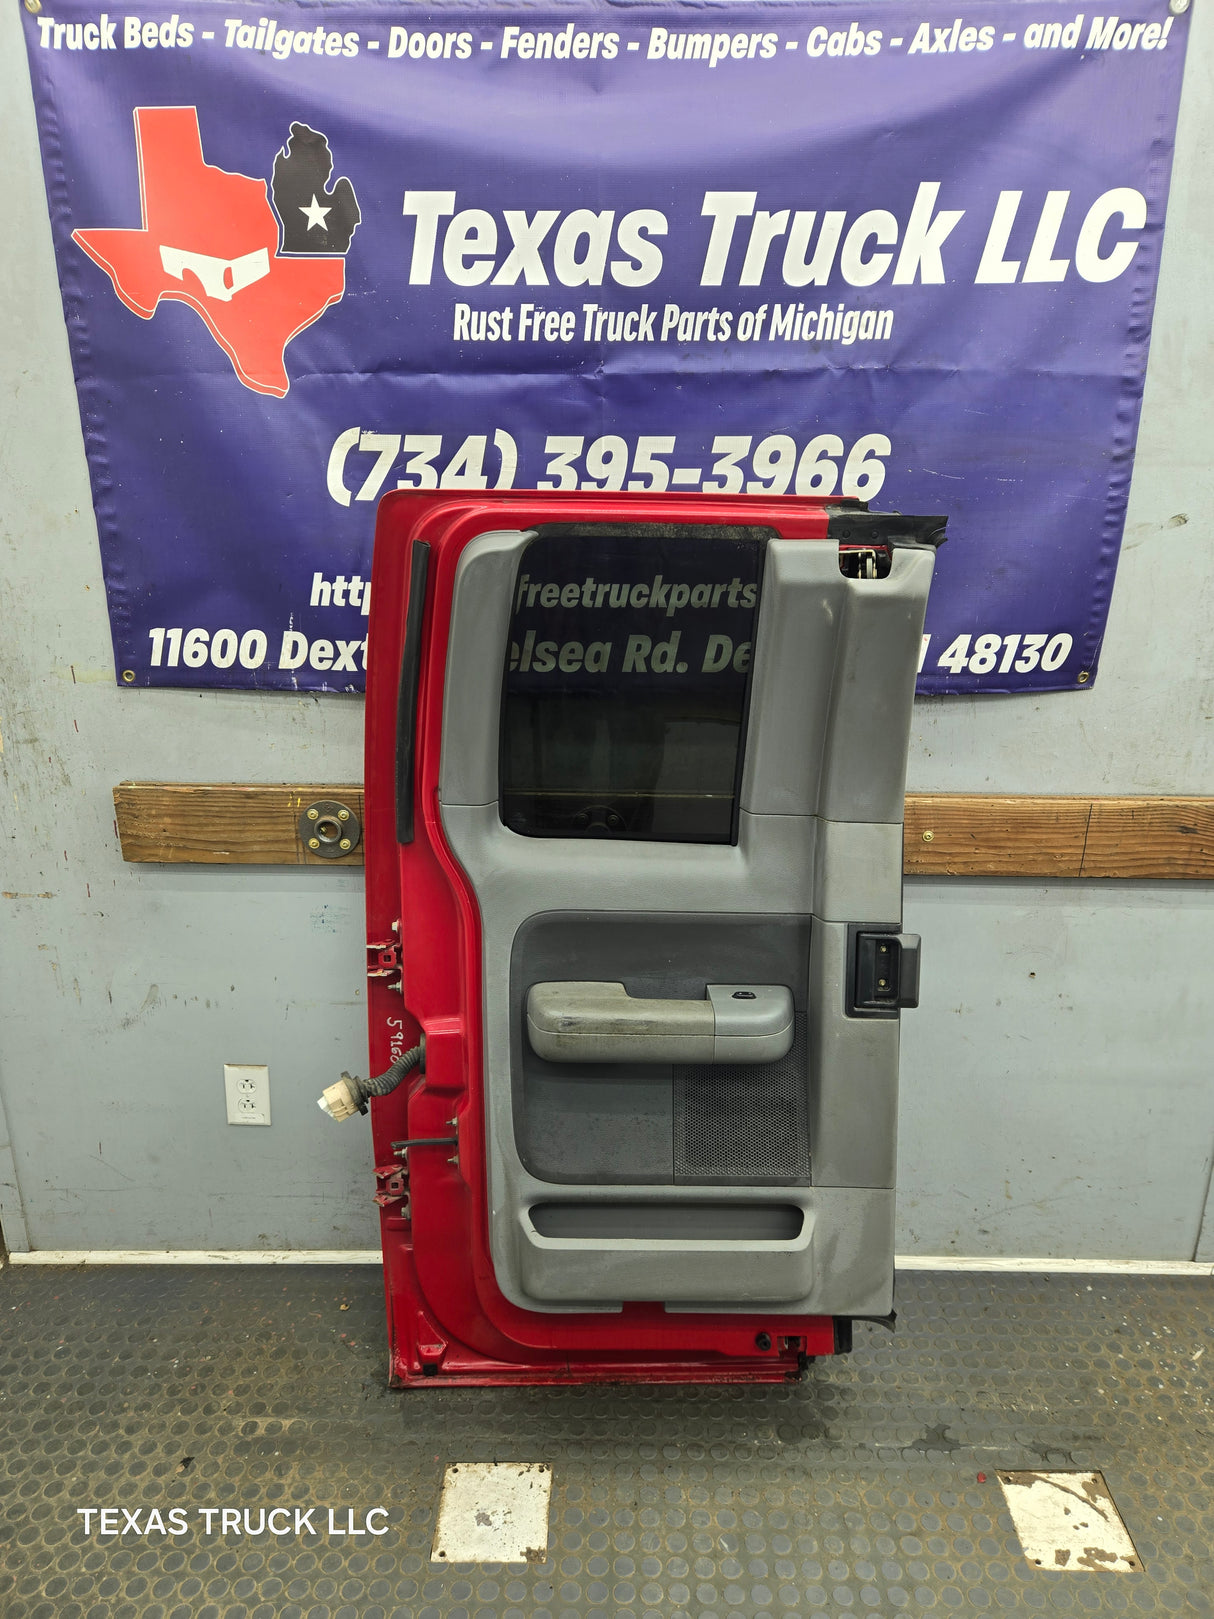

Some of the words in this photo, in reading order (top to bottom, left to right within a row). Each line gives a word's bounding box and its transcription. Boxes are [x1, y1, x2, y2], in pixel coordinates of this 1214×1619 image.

[37, 14, 117, 50] Truck
[124, 14, 194, 48] Beds
[224, 17, 360, 60] Tailgates
[388, 27, 473, 59] Doors
[500, 24, 619, 60] Fenders
[647, 27, 778, 68] Bumpers
[807, 22, 883, 57] Cabs
[907, 19, 996, 55] Axles
[1023, 14, 1084, 50] and
[1085, 16, 1175, 51] More!
[402, 190, 669, 287] Texas
[700, 181, 966, 287] Truck
[974, 187, 1148, 284] LLC
[453, 303, 513, 342] Rust
[518, 304, 576, 342] Free
[583, 303, 656, 342] Truck
[660, 303, 733, 342] Parts
[737, 303, 769, 342] of
[768, 303, 894, 346] Michigan
[326, 426, 518, 507] (734)
[537, 433, 892, 502] 395-3966
[148, 627, 268, 668] 11600
[621, 630, 689, 673] Rd.
[937, 633, 1073, 674] 48130
